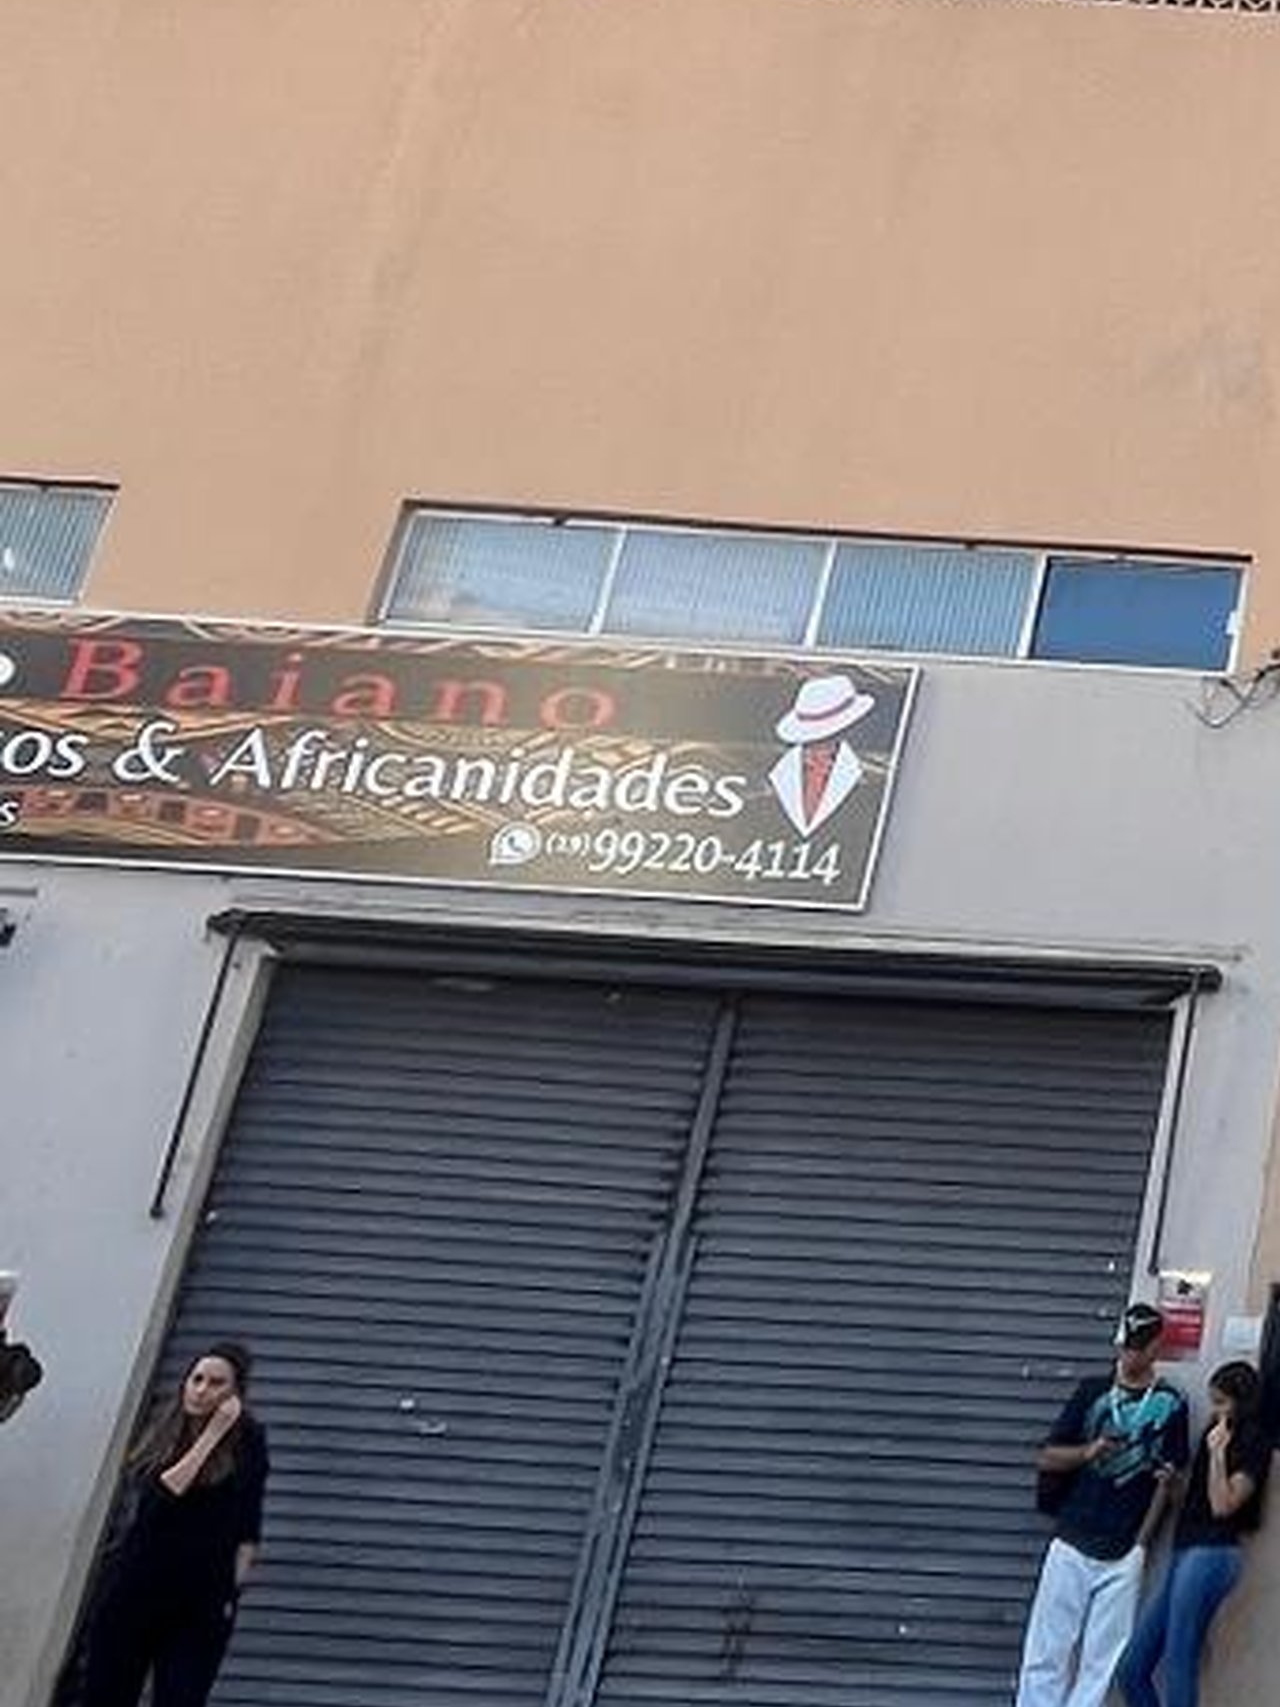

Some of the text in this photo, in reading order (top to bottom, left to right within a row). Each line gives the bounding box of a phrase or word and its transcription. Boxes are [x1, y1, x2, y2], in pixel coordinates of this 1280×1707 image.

[58, 633, 615, 729] Baiano
[114, 721, 187, 783] &
[210, 727, 748, 818] Africanidades
